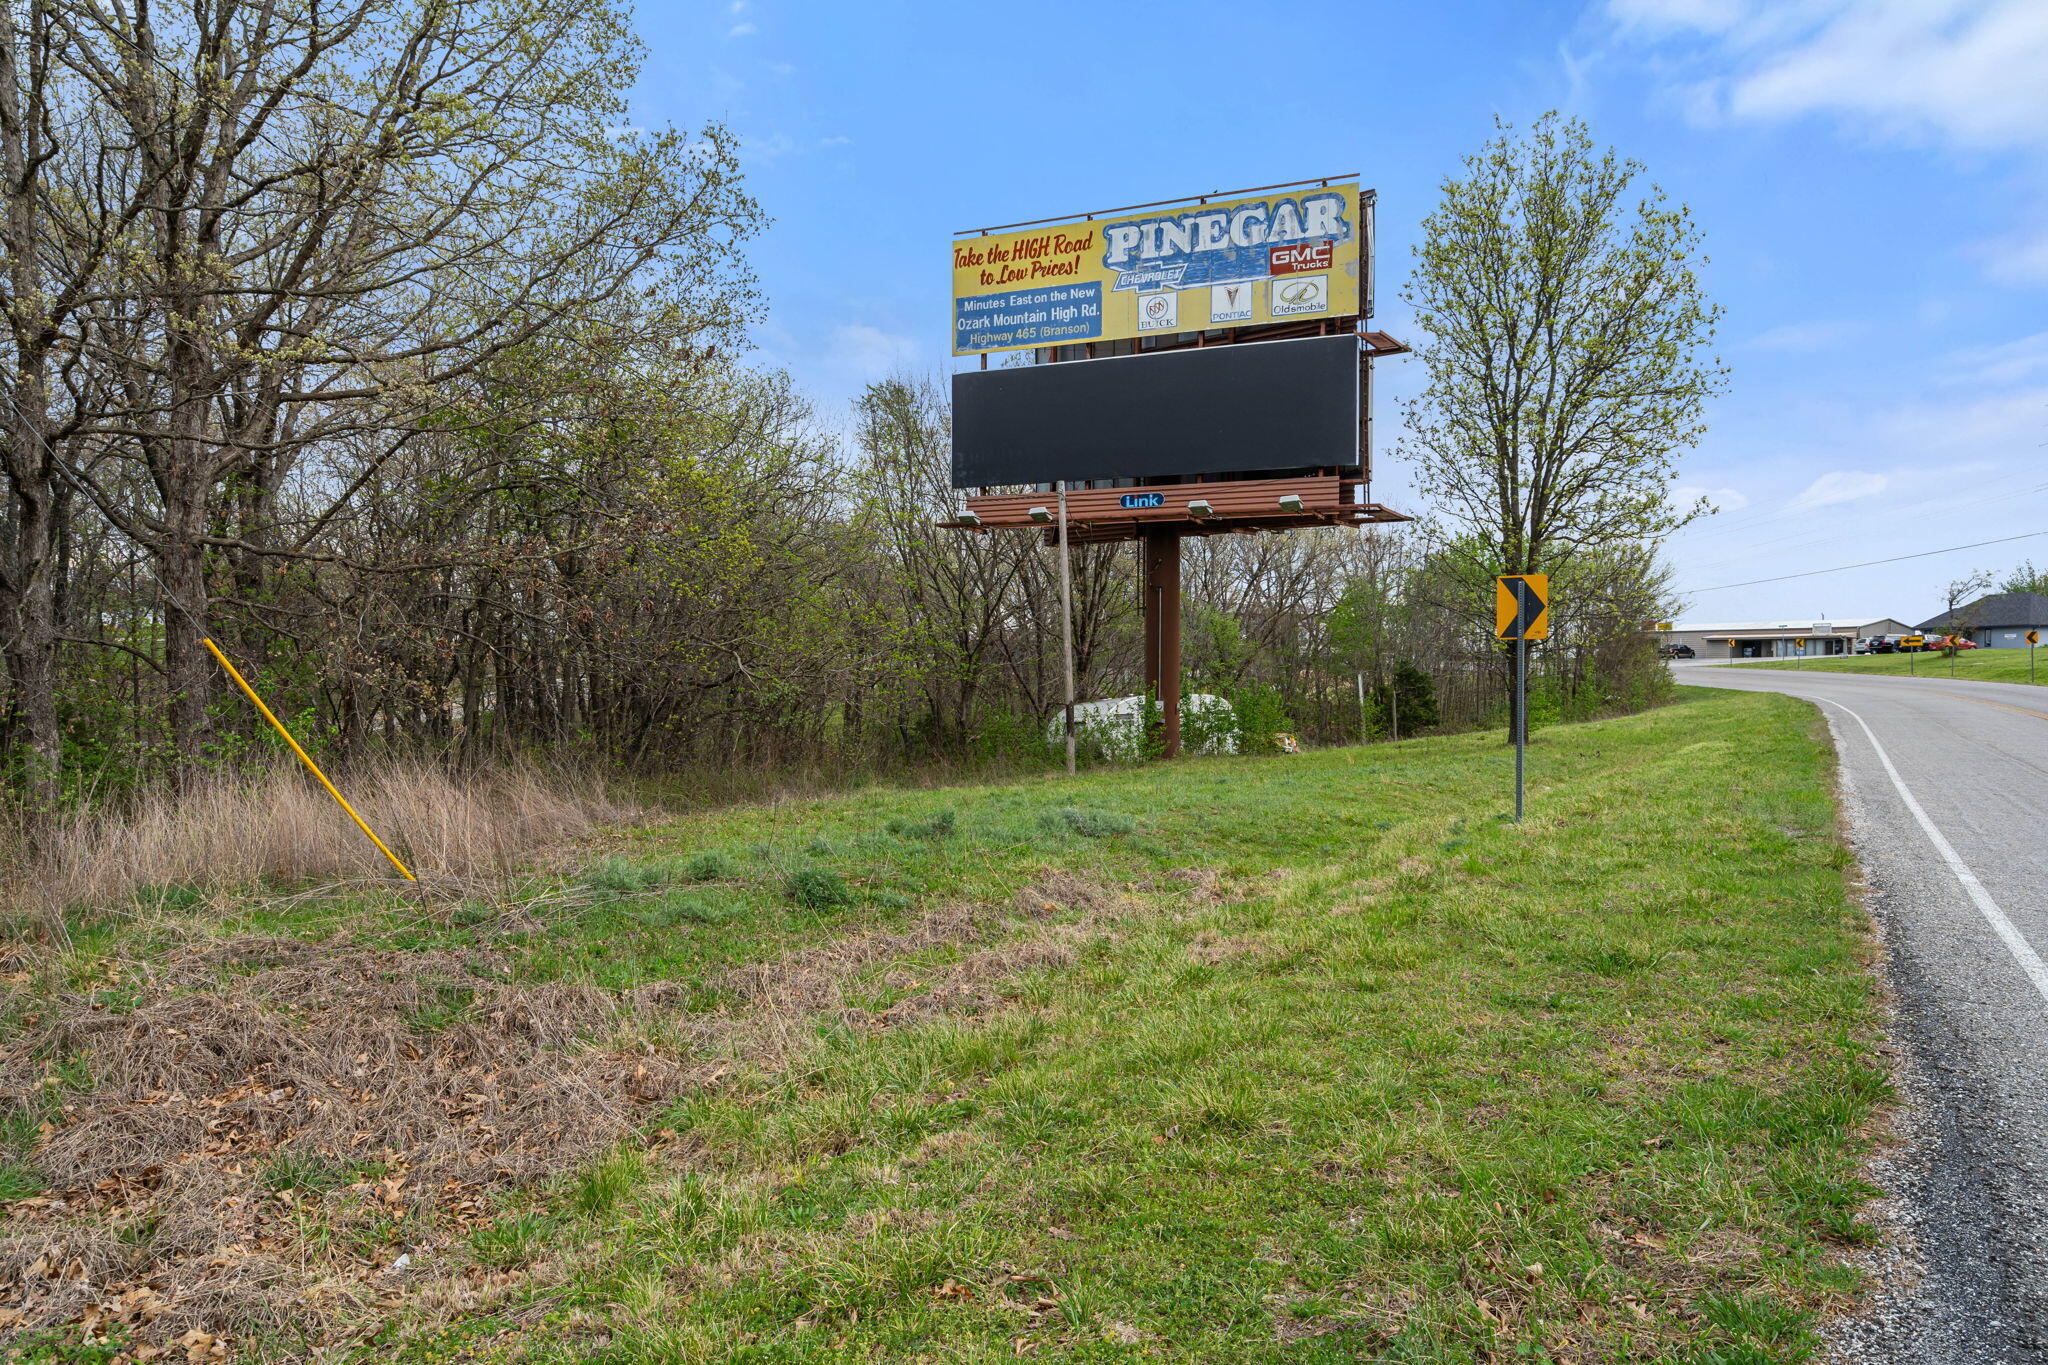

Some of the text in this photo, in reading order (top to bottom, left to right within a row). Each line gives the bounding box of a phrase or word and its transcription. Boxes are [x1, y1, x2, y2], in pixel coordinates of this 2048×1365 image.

[1106, 197, 1348, 263] PINEGAR
[954, 230, 1093, 269] Take the HIGH Road
[1272, 246, 1331, 265] GMC
[980, 254, 1080, 286] to Low Prices!
[1292, 260, 1328, 270] Trucks
[1121, 268, 1182, 285] CHEVROLET
[964, 288, 1095, 311] Minutes East on the New
[1273, 302, 1326, 315] Oldsmobile
[958, 304, 1100, 330] Ozark Mountain High Rd.
[1141, 319, 1174, 329] BUICK
[1212, 309, 1251, 321] PONTIAC
[970, 322, 1090, 344] Highway 465 (Branson)
[1126, 494, 1159, 508] Link
